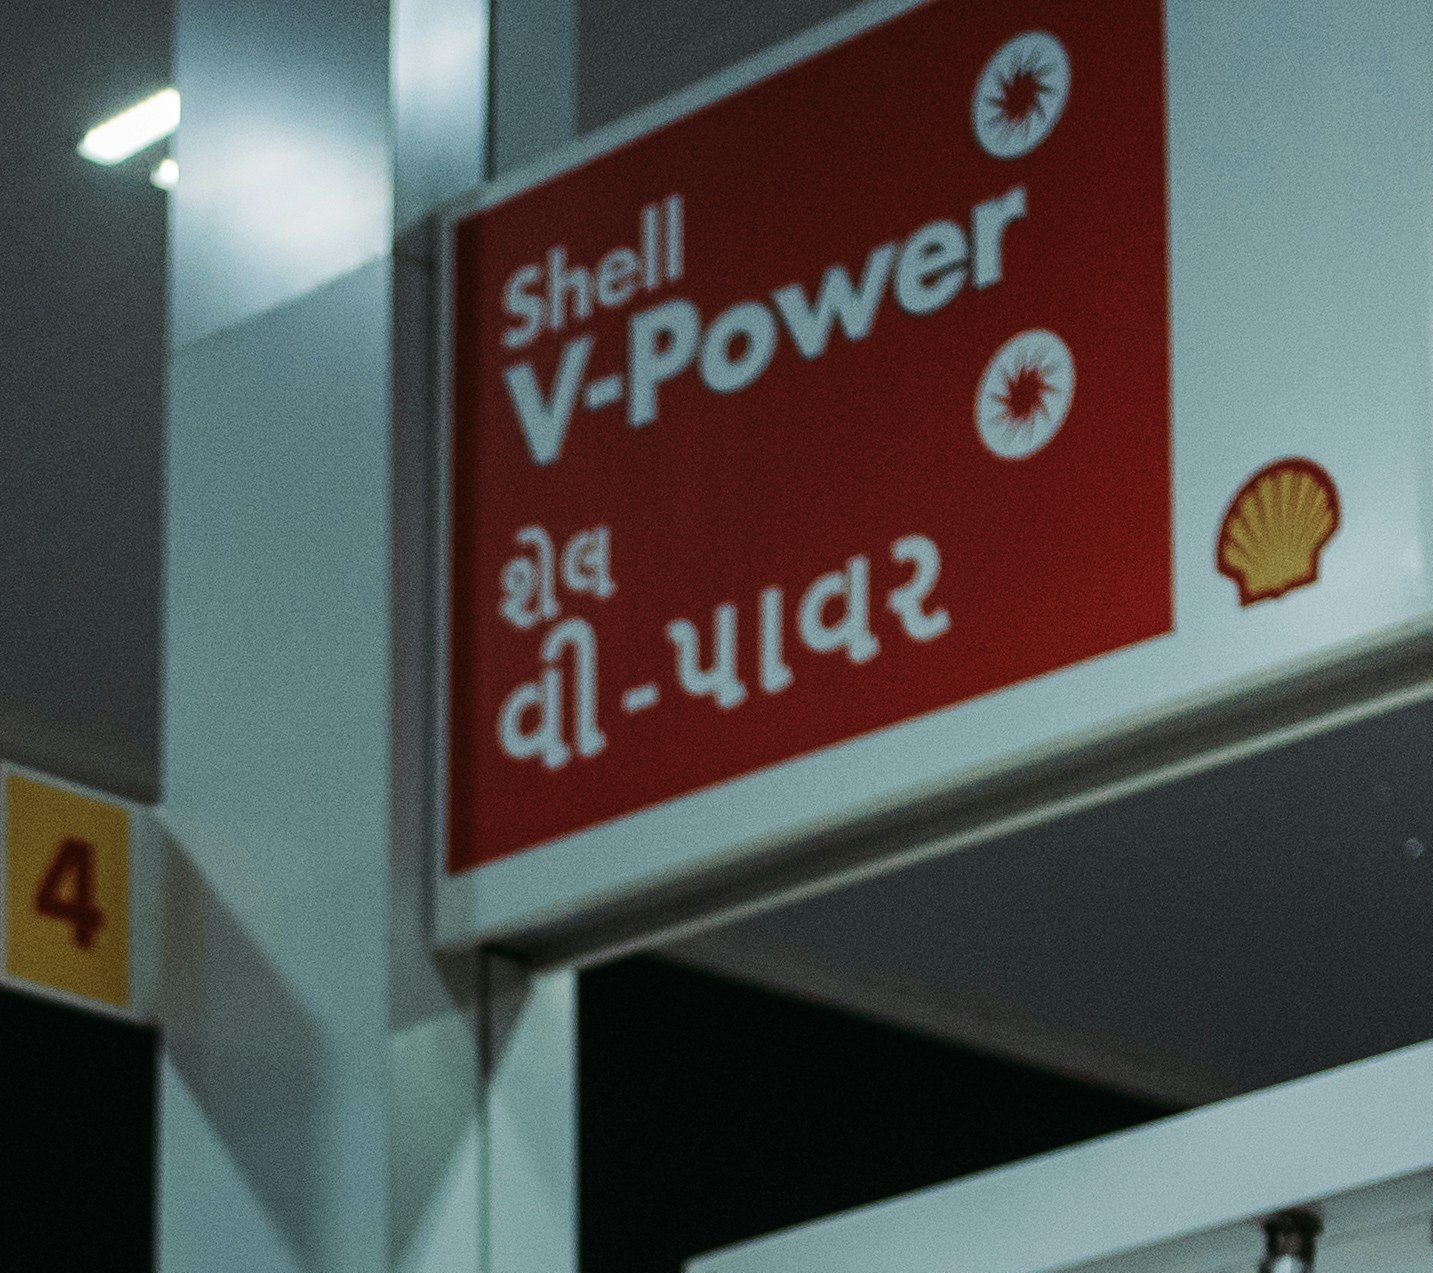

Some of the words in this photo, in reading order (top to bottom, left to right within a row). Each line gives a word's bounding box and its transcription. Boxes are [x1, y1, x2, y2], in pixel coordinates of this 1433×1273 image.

[500, 193, 686, 351] Shell
[502, 185, 1029, 467] V-Power
[495, 532, 954, 771] વી-પાવર
[498, 523, 618, 630] શેલ
[33, 838, 106, 950] 4
